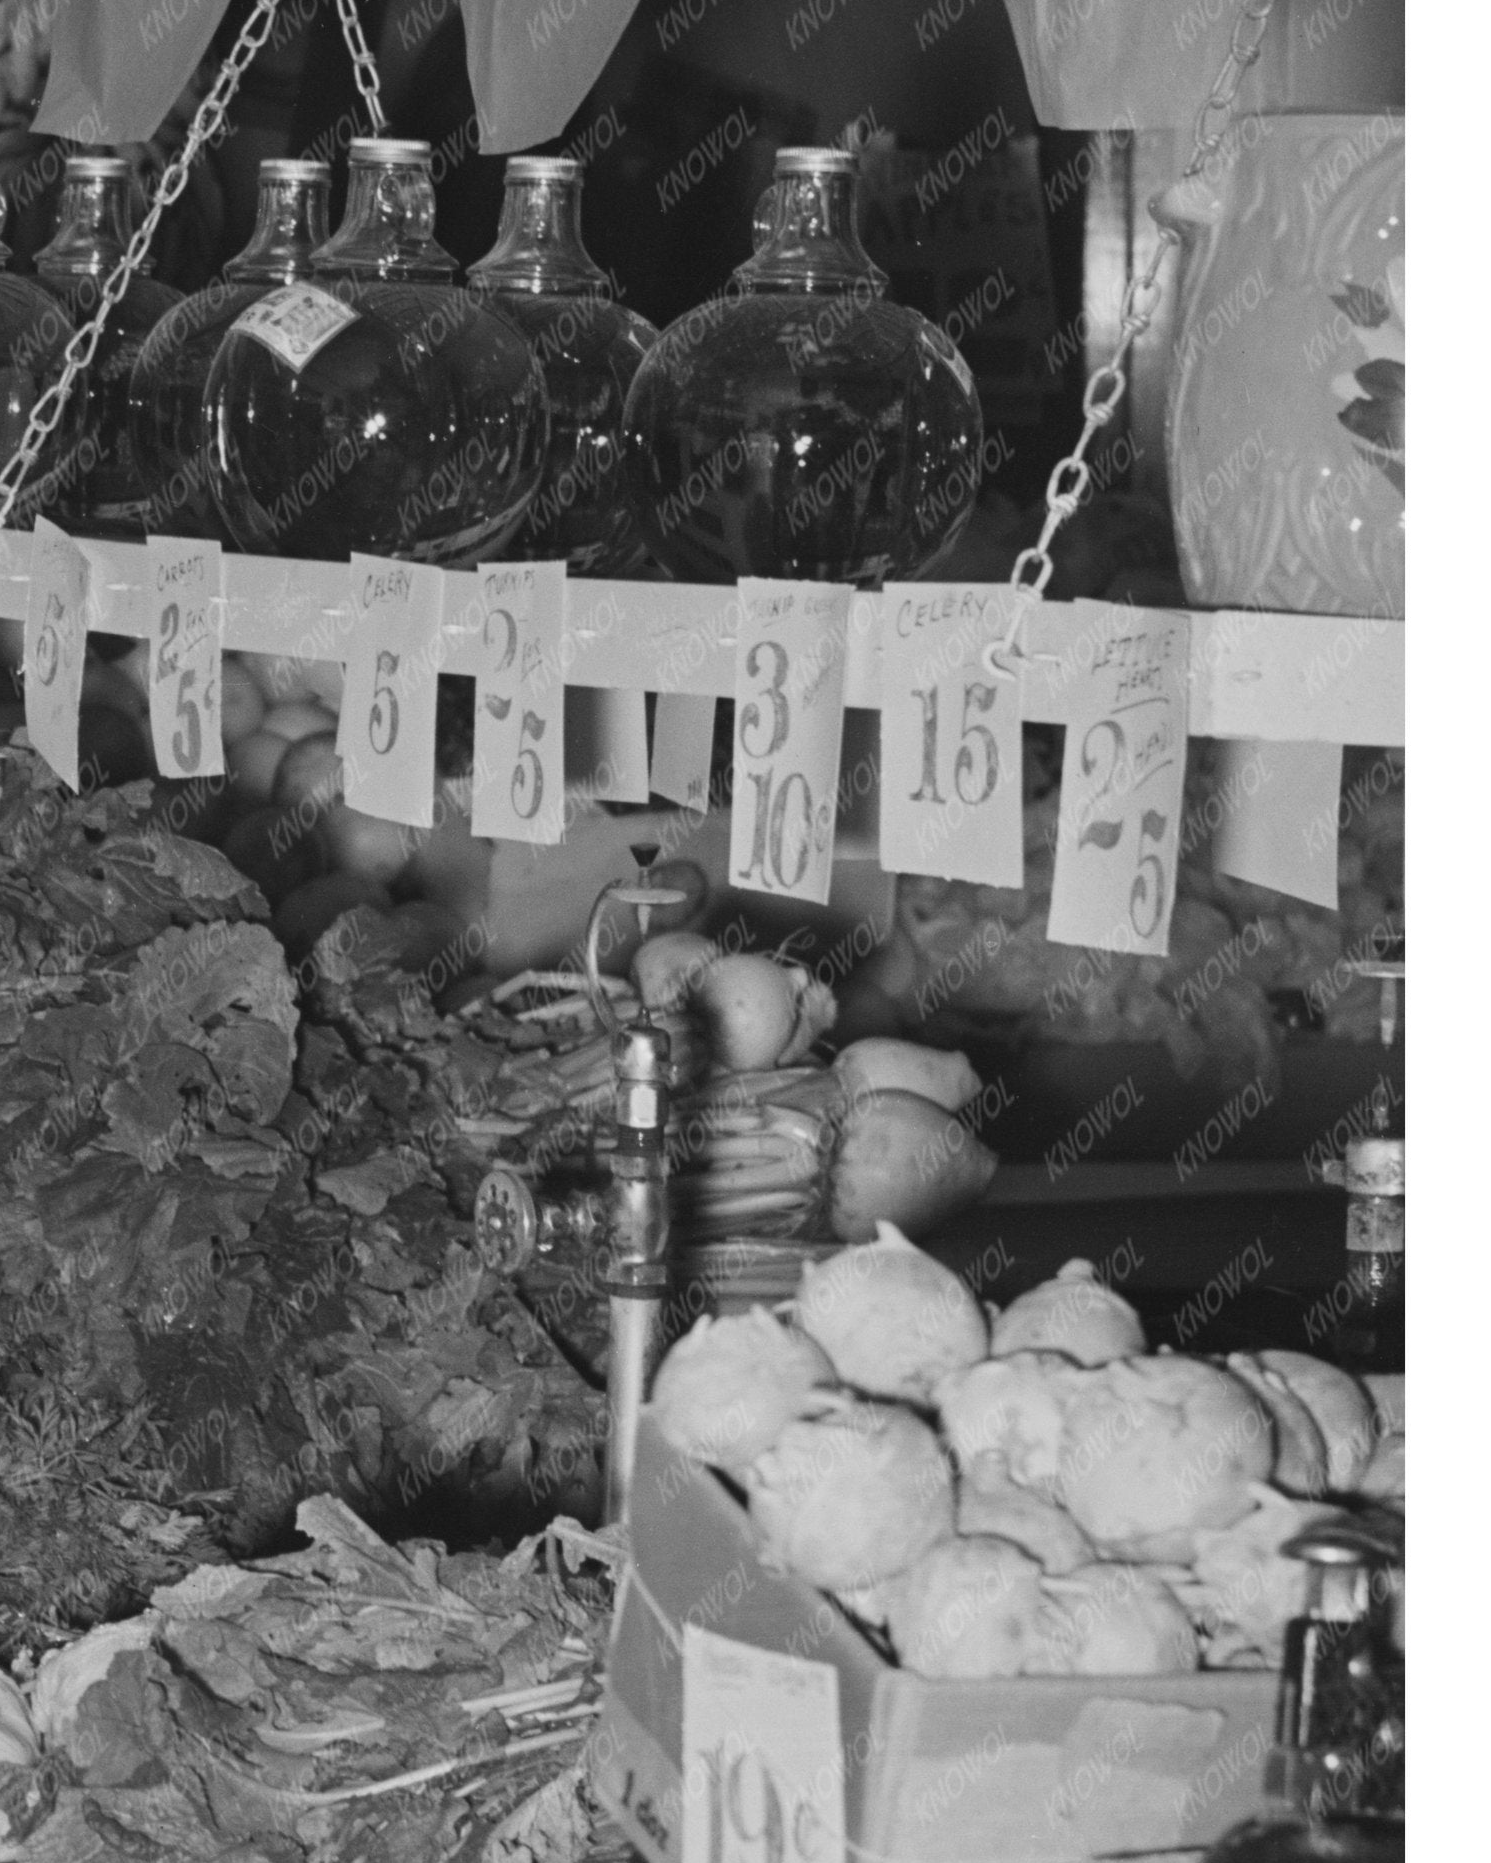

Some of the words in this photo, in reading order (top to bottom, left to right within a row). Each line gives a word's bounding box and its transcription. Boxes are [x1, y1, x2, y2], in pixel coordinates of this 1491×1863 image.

[156, 554, 205, 592] CARROTS
[361, 567, 413, 609] CELERY
[896, 591, 989, 639] CELERY
[368, 649, 400, 755] 5
[739, 640, 791, 759] 3
[908, 682, 1001, 806] 15
[510, 708, 546, 820] 5
[1127, 808, 1169, 940] 5
